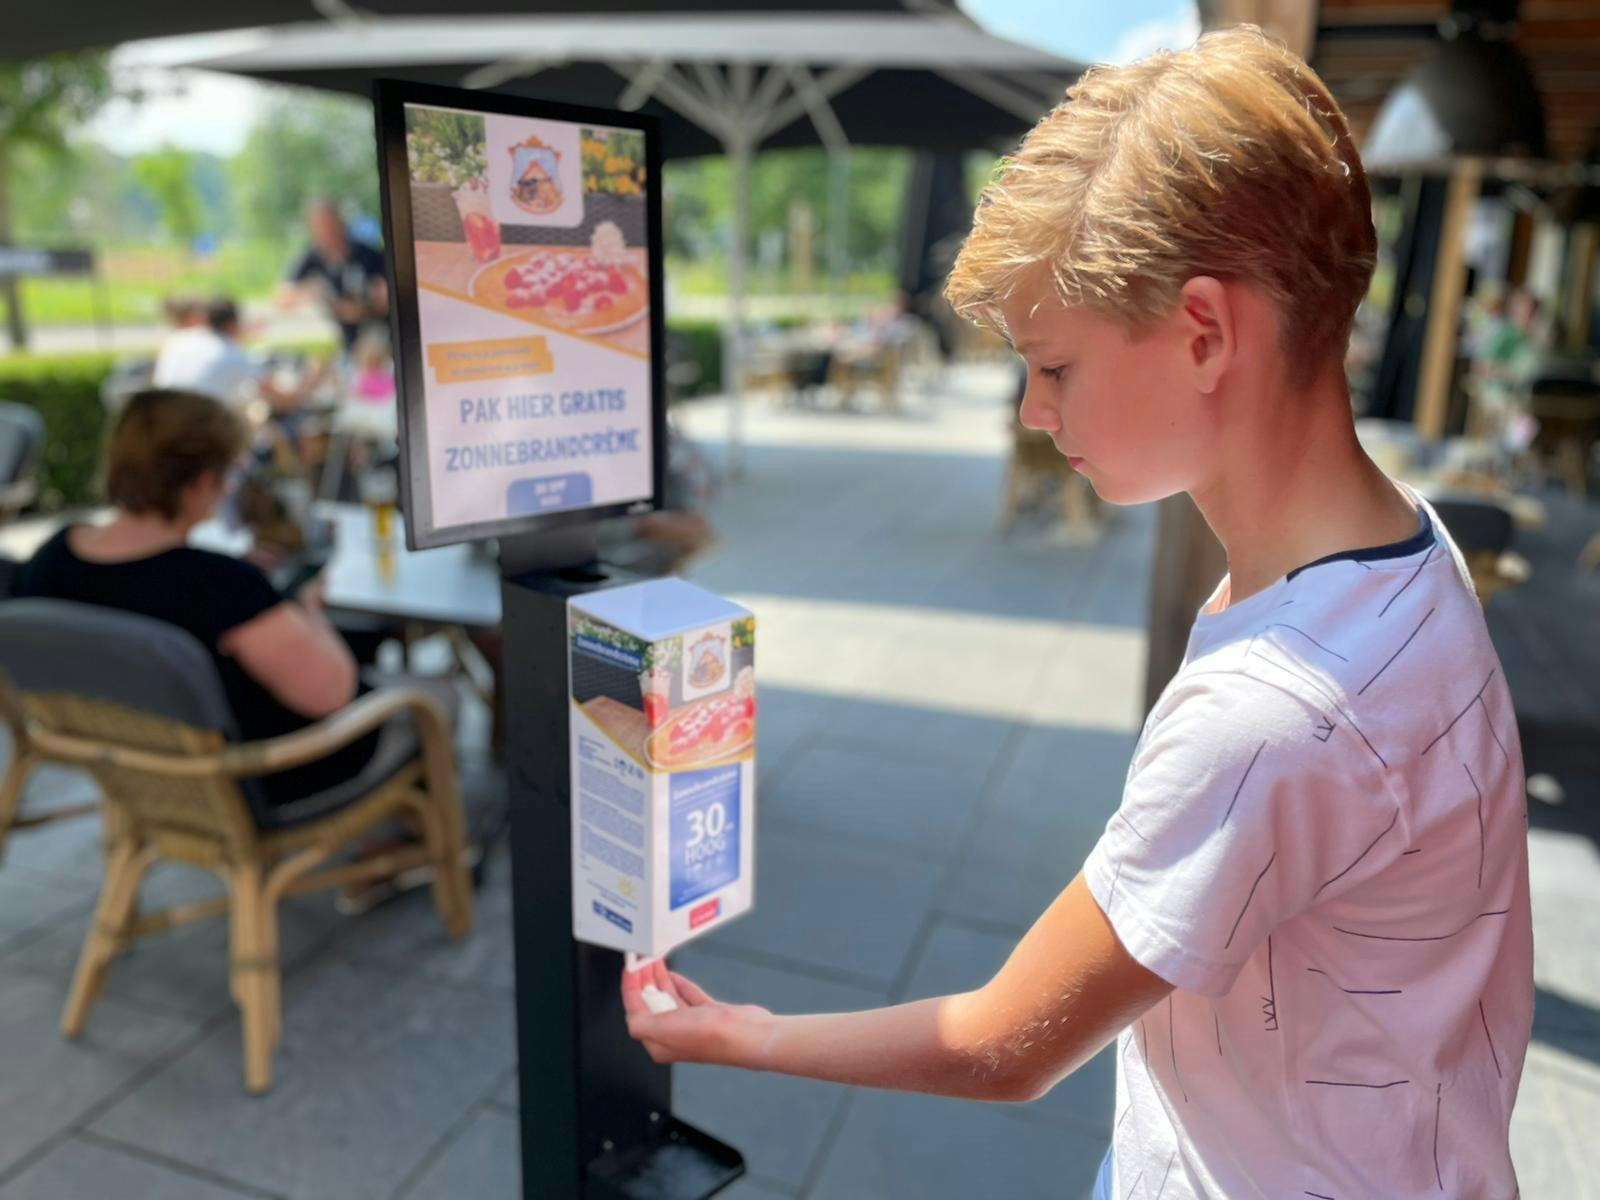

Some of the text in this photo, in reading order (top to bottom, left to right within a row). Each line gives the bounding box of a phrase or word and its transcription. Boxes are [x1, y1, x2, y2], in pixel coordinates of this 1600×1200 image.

[460, 388, 625, 423] PAK HIER GRATIS
[445, 427, 640, 473] ZONNEBRANDCRÈME
[685, 802, 726, 849] 30
